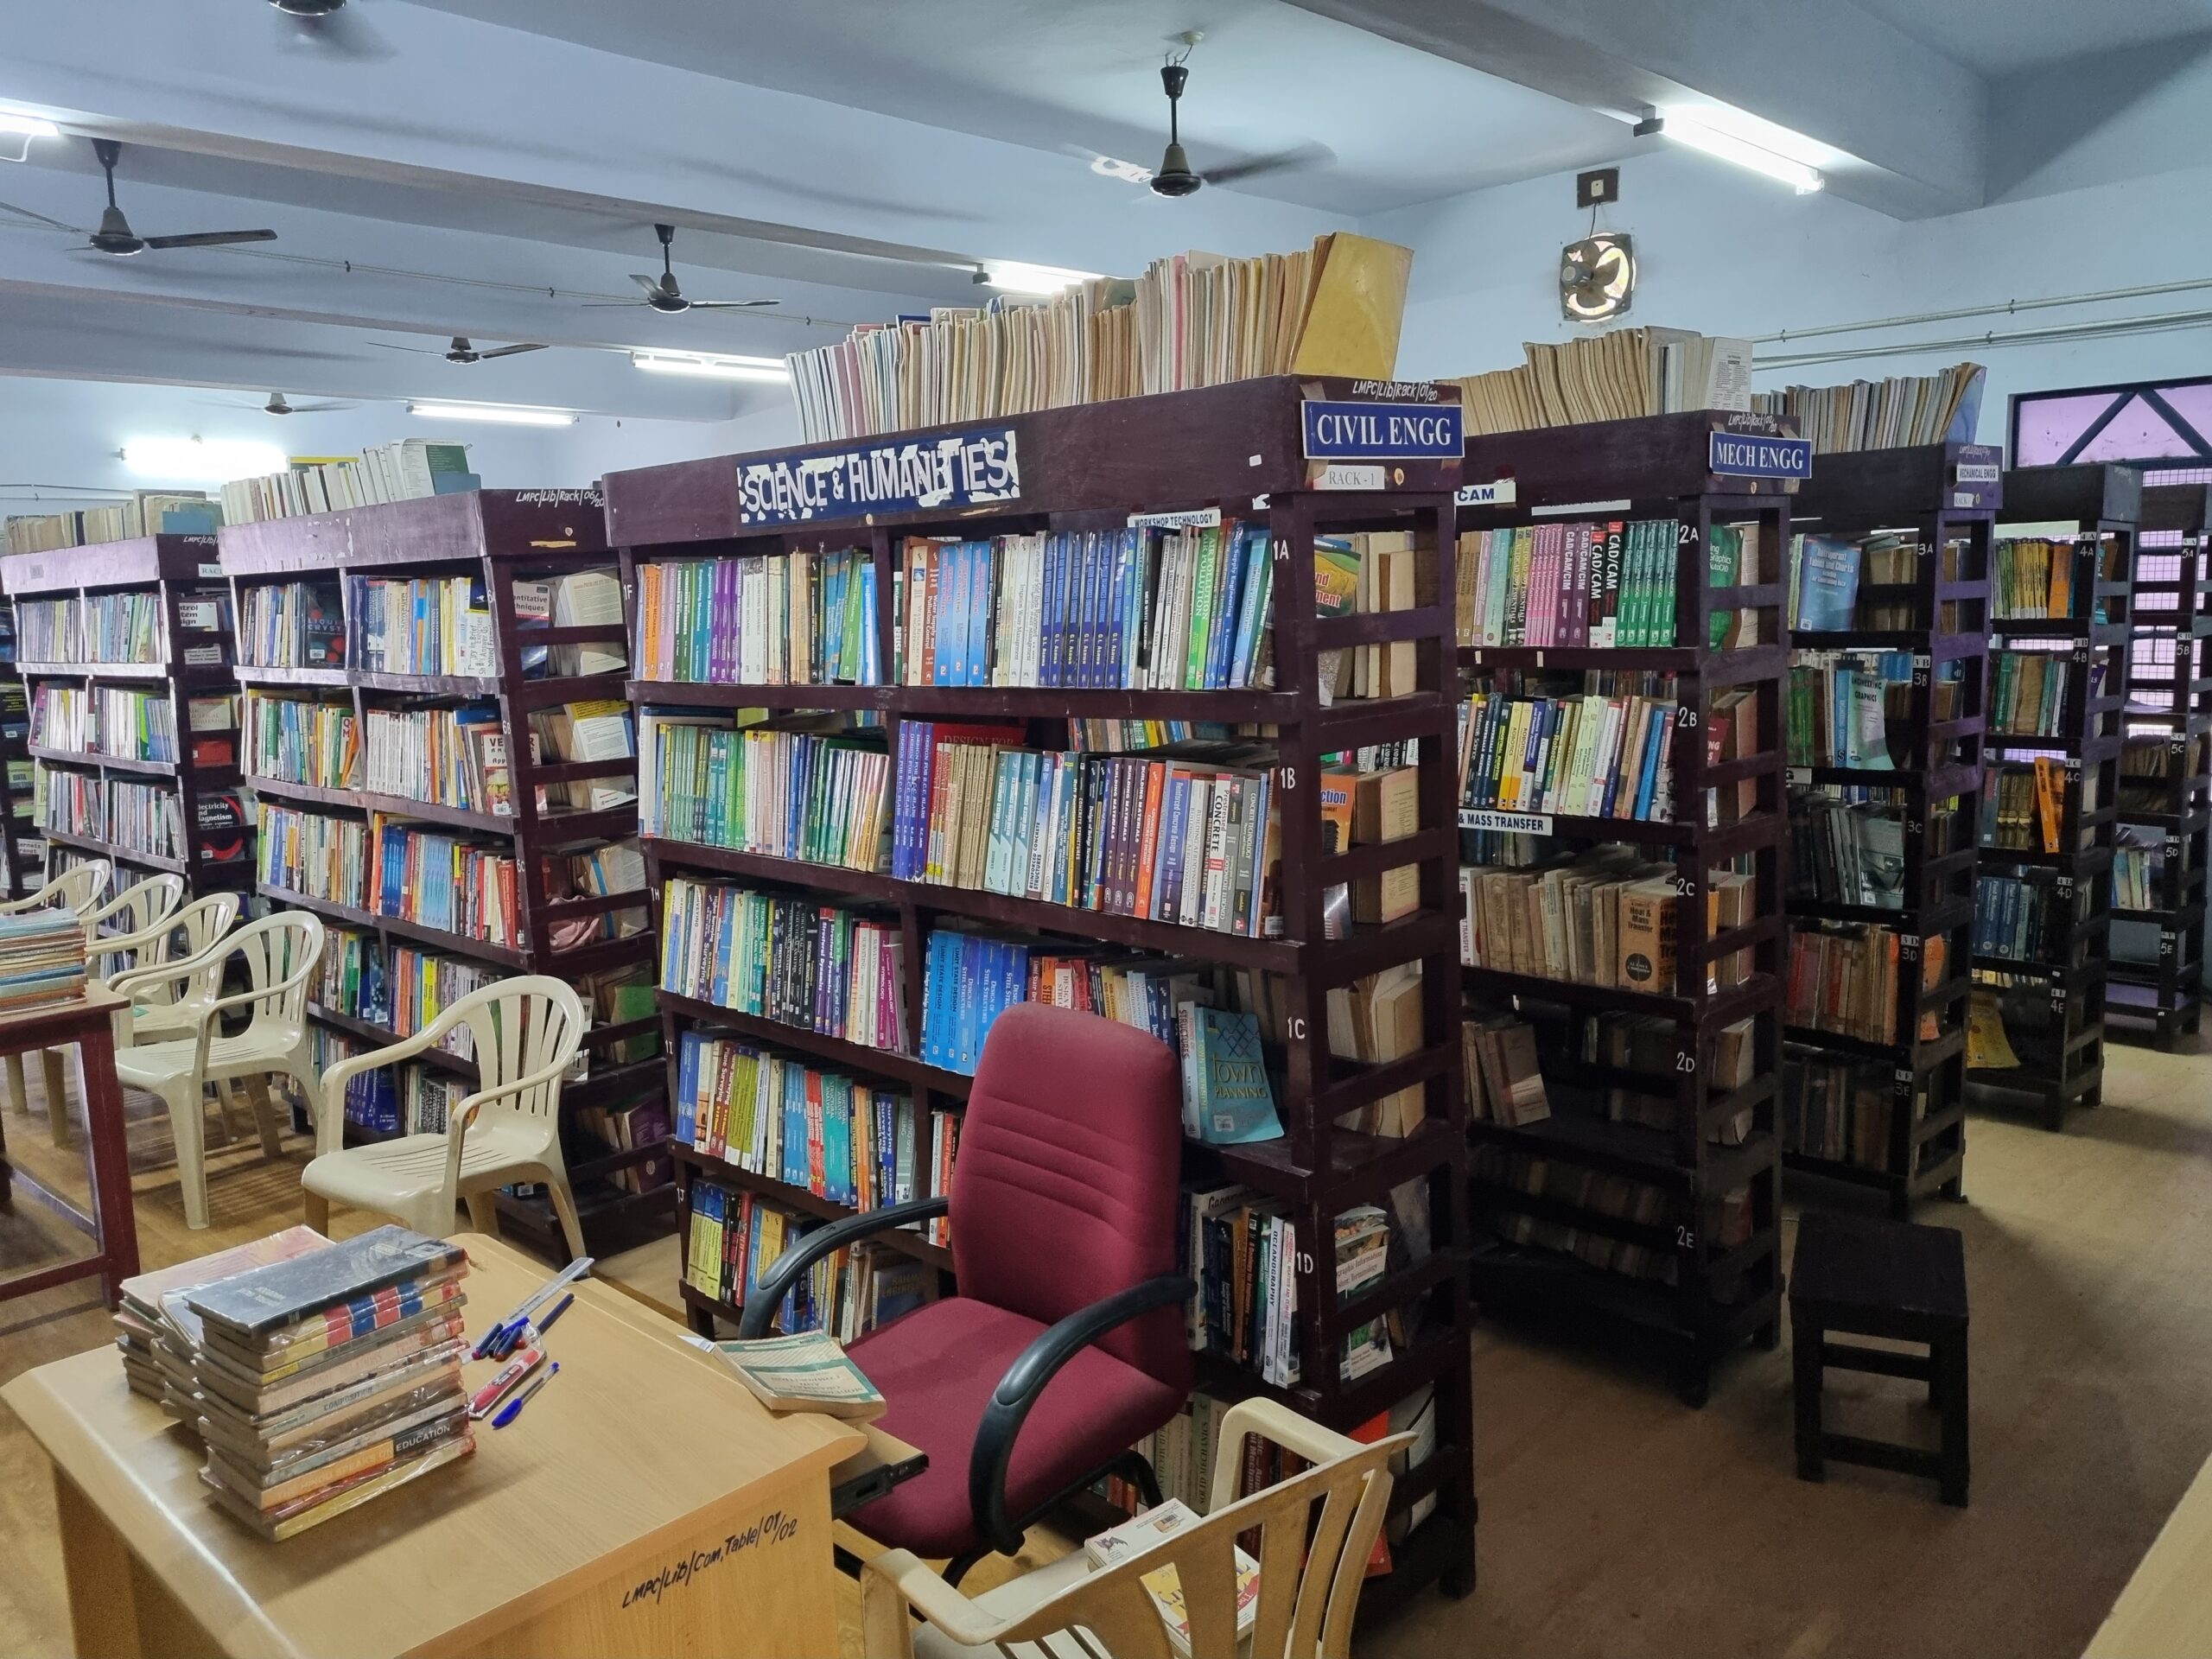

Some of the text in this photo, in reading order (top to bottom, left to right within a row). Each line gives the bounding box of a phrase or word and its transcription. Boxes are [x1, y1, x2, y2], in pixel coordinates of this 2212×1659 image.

[1317, 414, 1452, 446] CIVIL ENGG
[1716, 442, 1803, 469] MECH ENGG
[744, 462, 828, 512] SCIENCE
[832, 470, 844, 499] &
[1329, 471, 1362, 486] RACK
[1457, 488, 1495, 501] CAM
[1134, 513, 1213, 527] WORKSHOP TECHNOLOGY
[1679, 525, 1699, 543] 2A
[1274, 540, 1289, 560] 1A
[1918, 543, 1933, 556] 3A
[2080, 546, 2094, 556] 4A
[2182, 548, 2194, 558] 5A
[1562, 531, 1574, 590] CAD/CAM/CIM
[1577, 531, 1589, 590] CAD/CAM/CIM
[1605, 535, 1621, 589] CAD/CAM
[1834, 563, 1854, 573] Charts
[1202, 538, 1216, 620] AIR POLLUTION
[1591, 545, 1603, 599] CAD/CAM
[623, 584, 632, 601] 1F
[1226, 576, 1236, 617] Engineering
[2074, 652, 2088, 663] 4B
[2177, 645, 2190, 656] 5B
[1914, 672, 1927, 685] 3B
[1855, 691, 1877, 702] GRAPHICS
[502, 720, 511, 734] 6B
[1679, 708, 1697, 727] 2B
[2171, 744, 2183, 753] 5C
[1280, 767, 1296, 789] 1B
[2064, 772, 2080, 783] 4C
[1135, 802, 1143, 842] MATERIALS
[1170, 783, 1183, 853] Reinforced Concrete Design
[1211, 796, 1223, 852] CONCRETE
[1467, 816, 1492, 828] MASS
[1494, 817, 1544, 831] TRANSFER
[1908, 820, 1923, 833] 3C
[1245, 823, 1254, 859] TECHNOLOGY
[2165, 847, 2178, 858] 5D
[1190, 846, 1198, 900] AERODYNAMICS
[1676, 878, 1694, 896] 2C
[2057, 887, 2072, 899] 4D
[723, 896, 732, 924] Levelling
[1902, 947, 1916, 961] 3D
[2160, 943, 2172, 954] 5E
[699, 943, 709, 983] Surveying
[2050, 1001, 2064, 1014] 4E
[1179, 1009, 1190, 1059] STRUCTURES
[1287, 1018, 1306, 1039] 1C
[1676, 1052, 1694, 1073] 2D
[716, 1068, 728, 1102] Surveying
[1215, 1087, 1268, 1099] PLANNING
[1895, 1083, 1910, 1096] 3E
[1676, 1226, 1694, 1248] 2E
[1269, 1230, 1279, 1306] OCEANOGRAPHY
[1296, 1251, 1313, 1274] 1D
[396, 1424, 451, 1454] EDUCATION
[1198, 1421, 1208, 1506] SOLID MECHANICS
